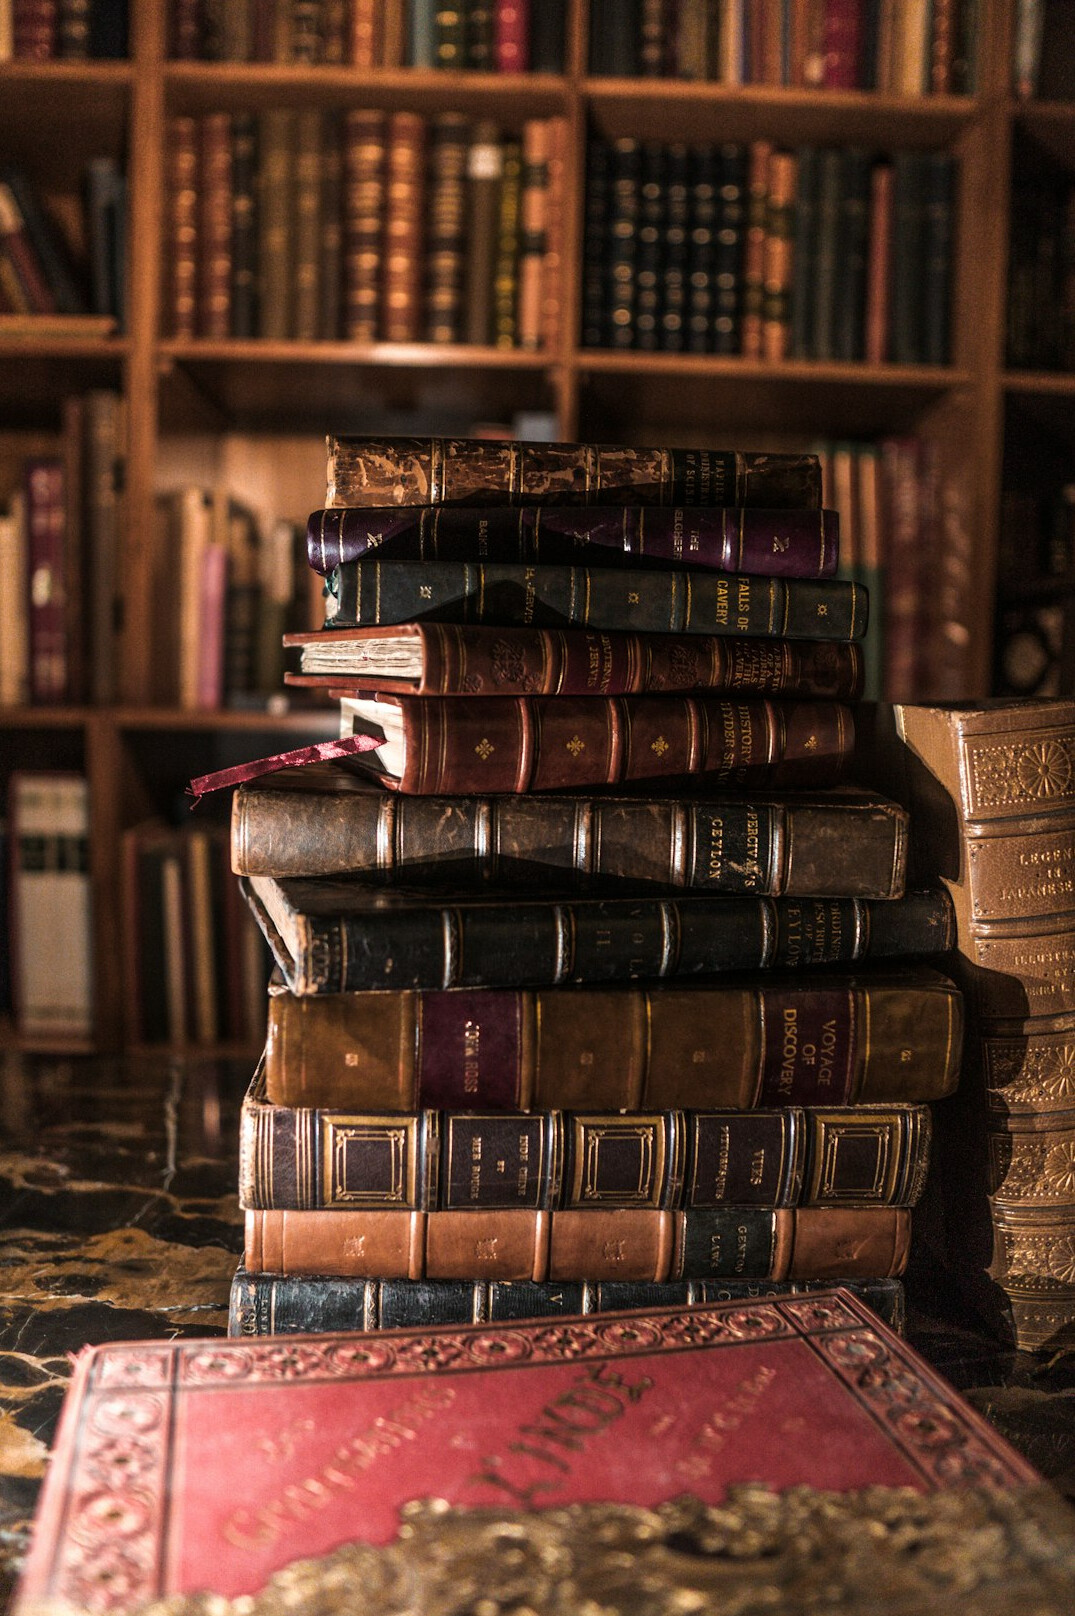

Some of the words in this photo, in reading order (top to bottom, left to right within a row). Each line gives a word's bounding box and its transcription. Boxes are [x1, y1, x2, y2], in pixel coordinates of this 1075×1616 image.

[689, 528, 700, 551] THE
[715, 579, 729, 626] CAVERY
[737, 577, 750, 613] FALLS
[736, 616, 749, 632] OF
[587, 645, 599, 687] JERVIS
[719, 701, 735, 748] HYDER
[738, 705, 753, 764] HISTORY
[709, 818, 724, 879] CEYLON
[1000, 879, 1074, 900] JAPANESE
[778, 1007, 798, 1096] DISCOVERY
[801, 1043, 817, 1067] OF
[817, 1018, 837, 1087] VOYAGE
[464, 1061, 480, 1093] ROSS
[750, 1148, 765, 1185] VUES
[734, 1225, 748, 1273] GENTOO
[260, 1299, 269, 1337] LOND
